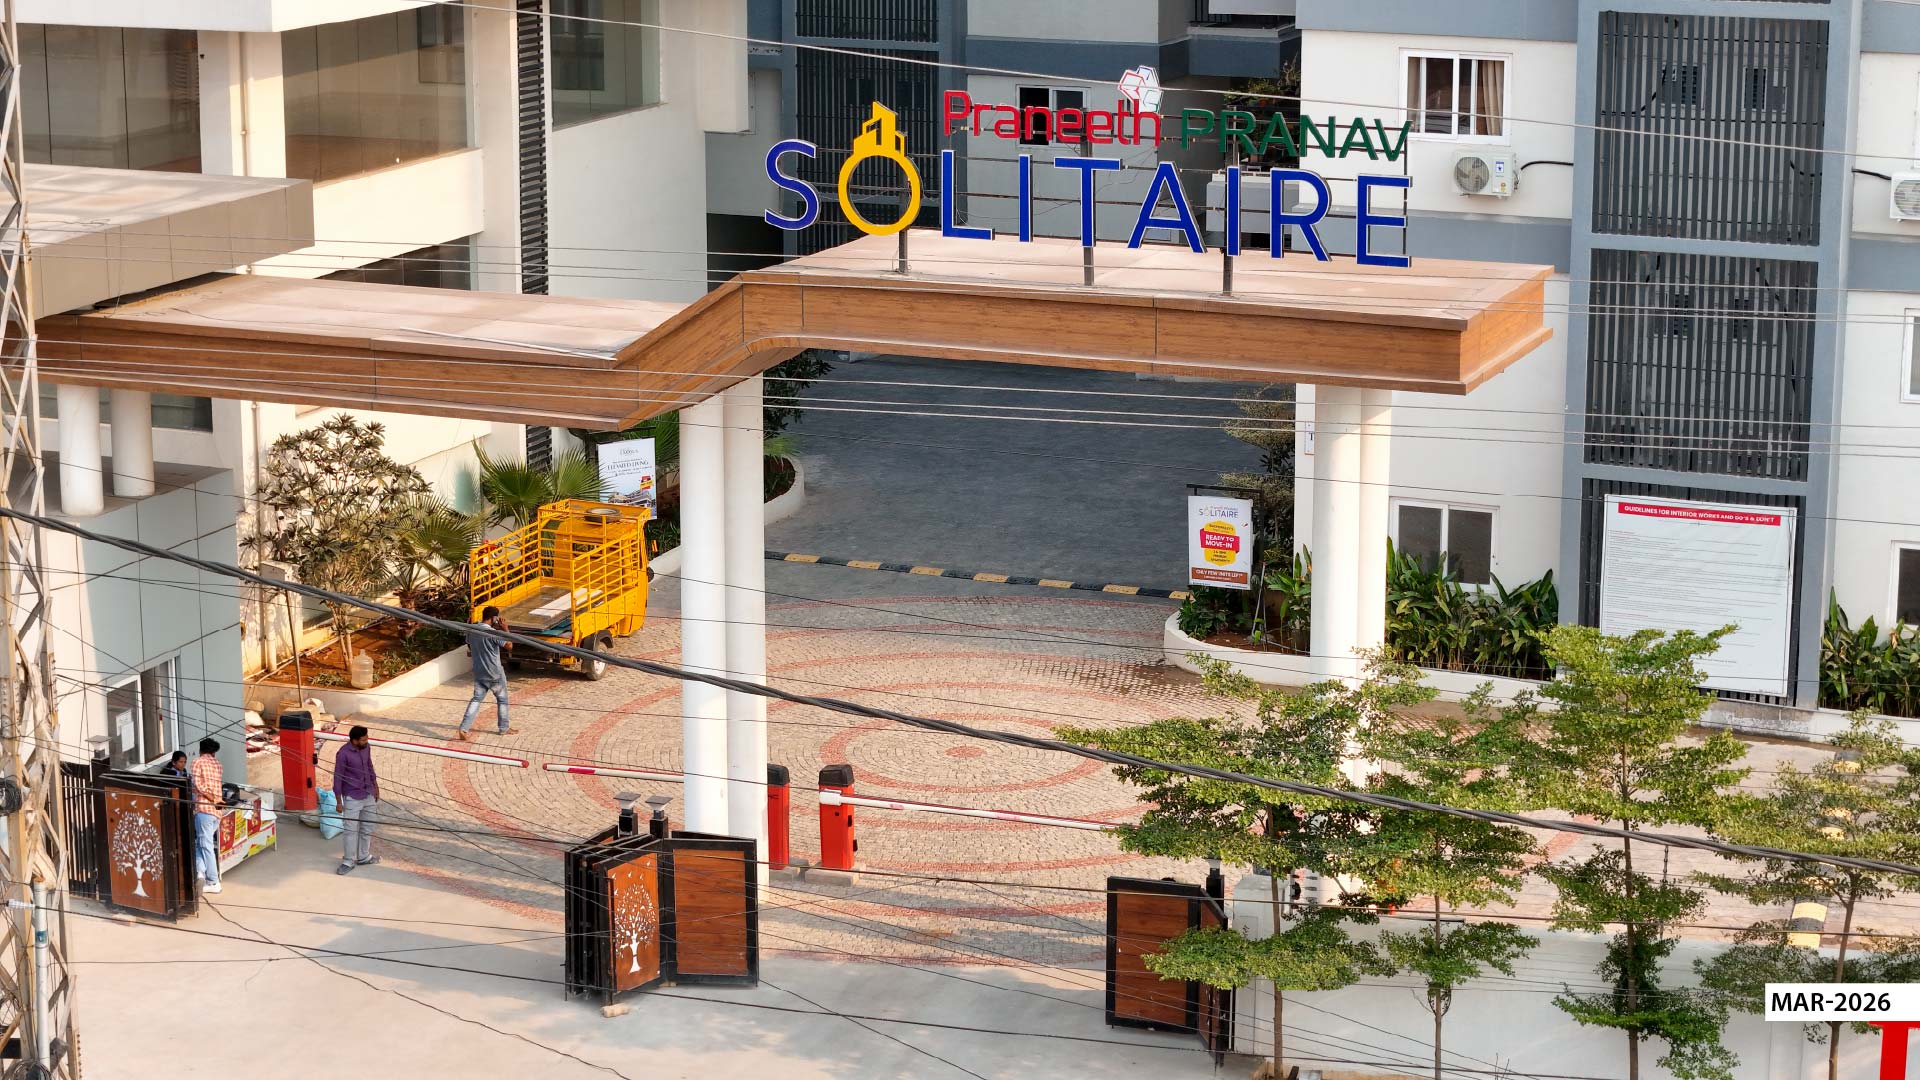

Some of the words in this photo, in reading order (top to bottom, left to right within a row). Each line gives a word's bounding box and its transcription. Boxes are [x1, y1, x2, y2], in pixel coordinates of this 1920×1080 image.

[943, 90, 1161, 147] Praneeth
[1181, 107, 1415, 162] PRANAV
[764, 120, 1413, 268] SOLITAIRE
[1199, 508, 1239, 519] SOLITAIRE
[1624, 505, 1658, 514] GUIDELINES
[1671, 510, 1697, 518] INTERIOR
[1205, 540, 1233, 549] MOVE-IN
